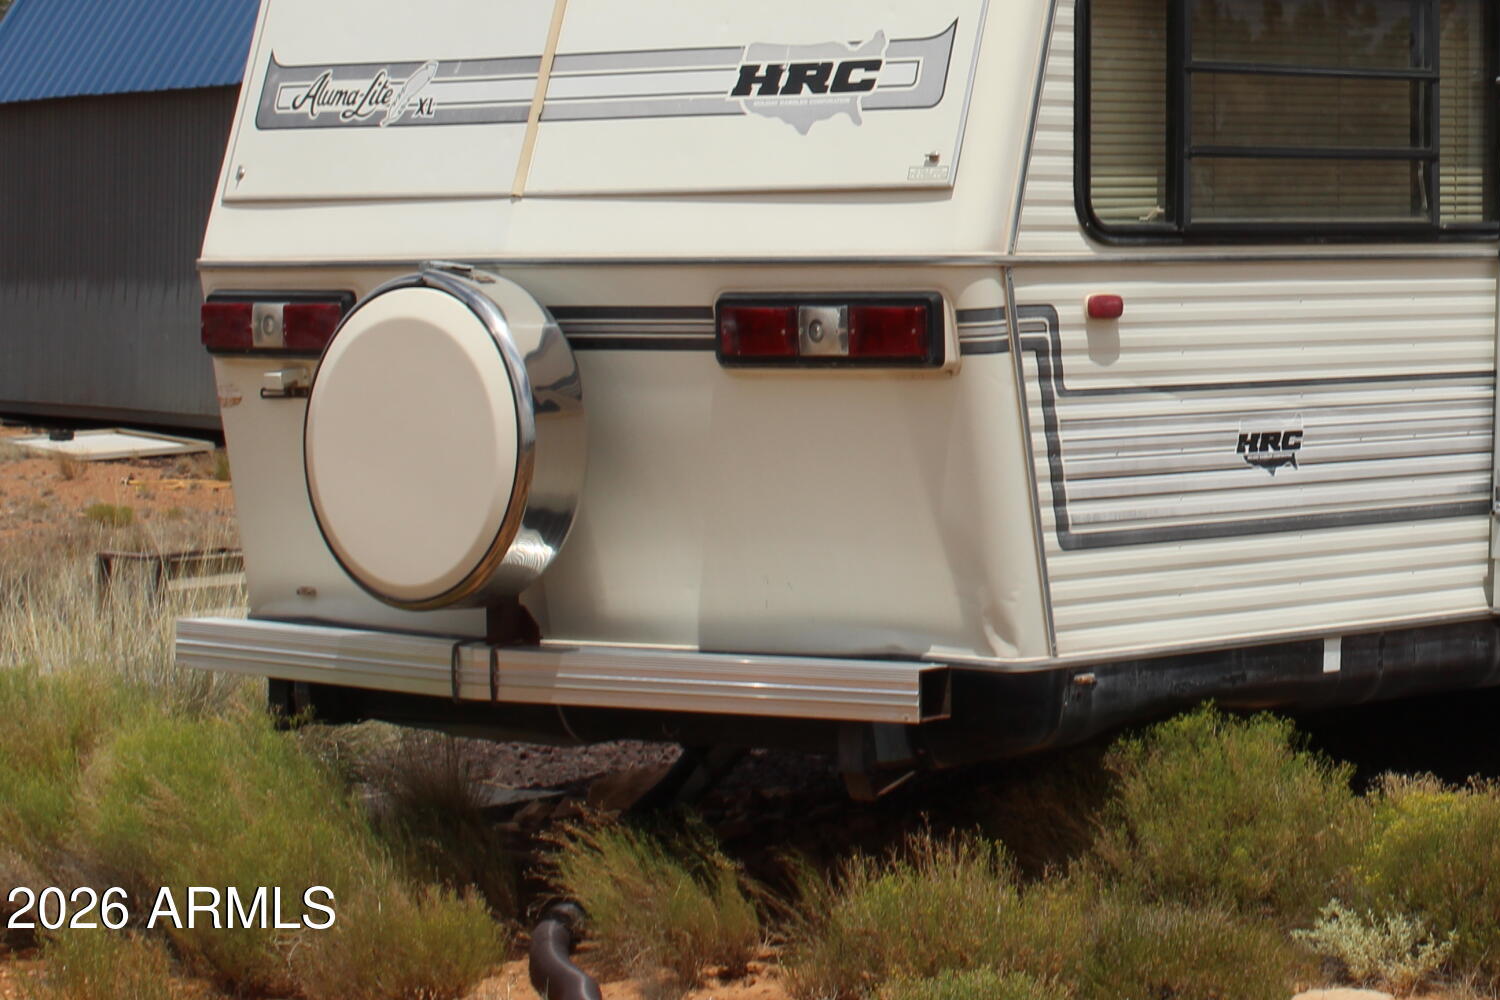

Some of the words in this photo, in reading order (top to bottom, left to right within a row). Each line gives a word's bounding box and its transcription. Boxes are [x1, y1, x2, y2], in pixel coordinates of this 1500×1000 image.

[730, 59, 883, 97] HRC
[415, 97, 435, 116] XL
[1236, 430, 1304, 454] HRC
